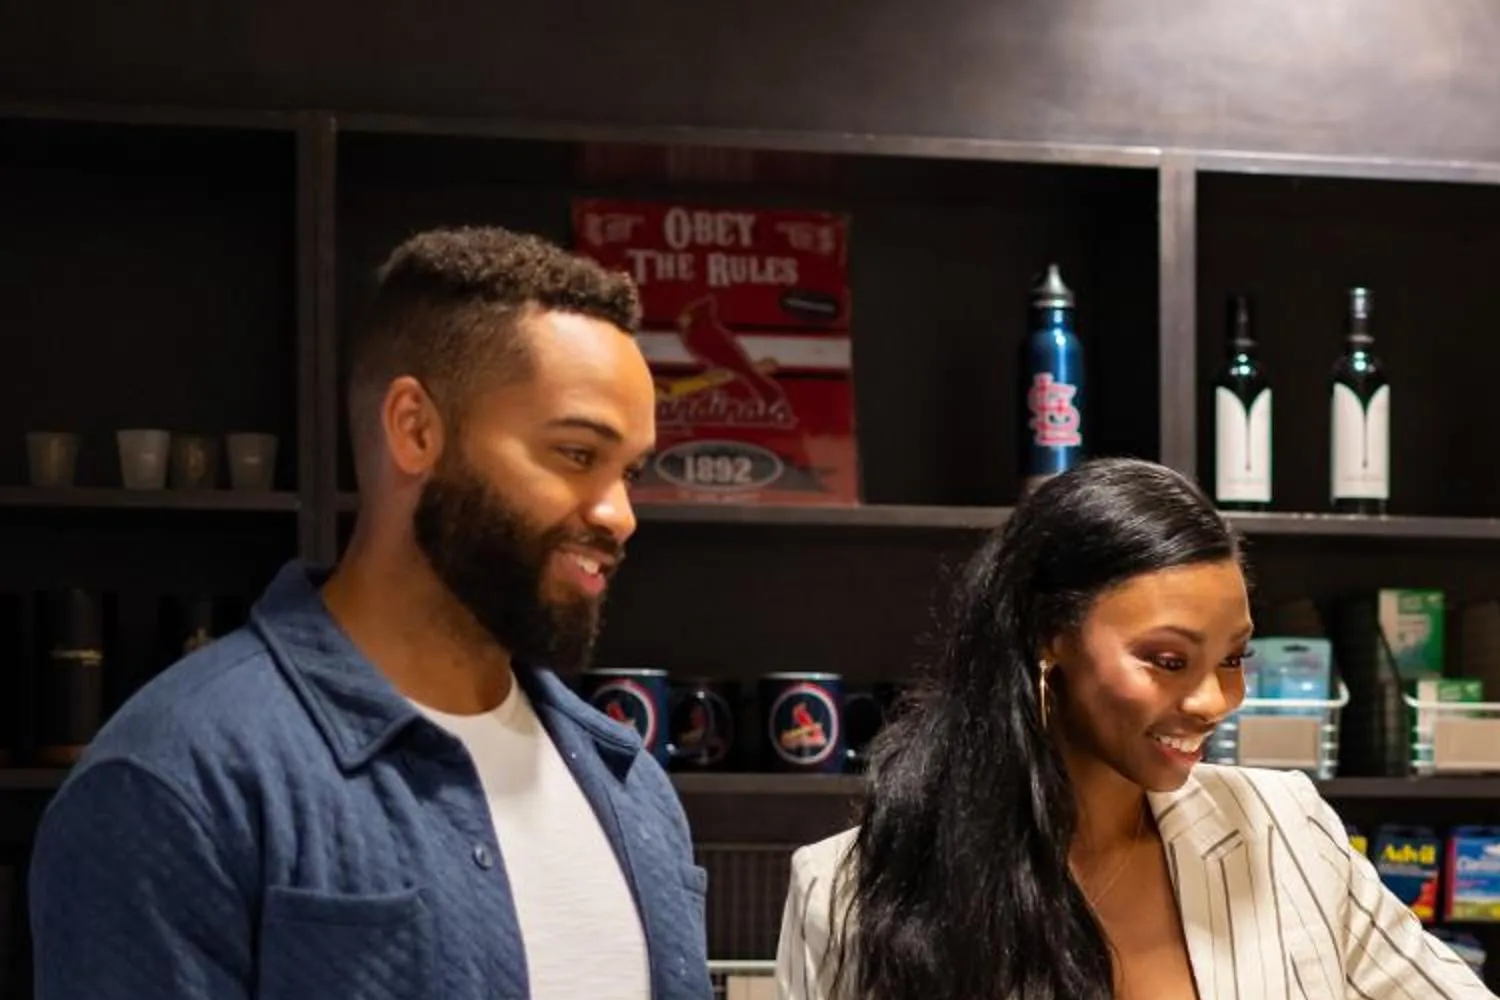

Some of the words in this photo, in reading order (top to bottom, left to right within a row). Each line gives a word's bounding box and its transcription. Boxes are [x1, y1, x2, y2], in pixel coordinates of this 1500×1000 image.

[664, 207, 755, 249] OBEY
[627, 249, 694, 285] THE
[707, 252, 798, 286] RULES
[683, 455, 753, 484] 1892
